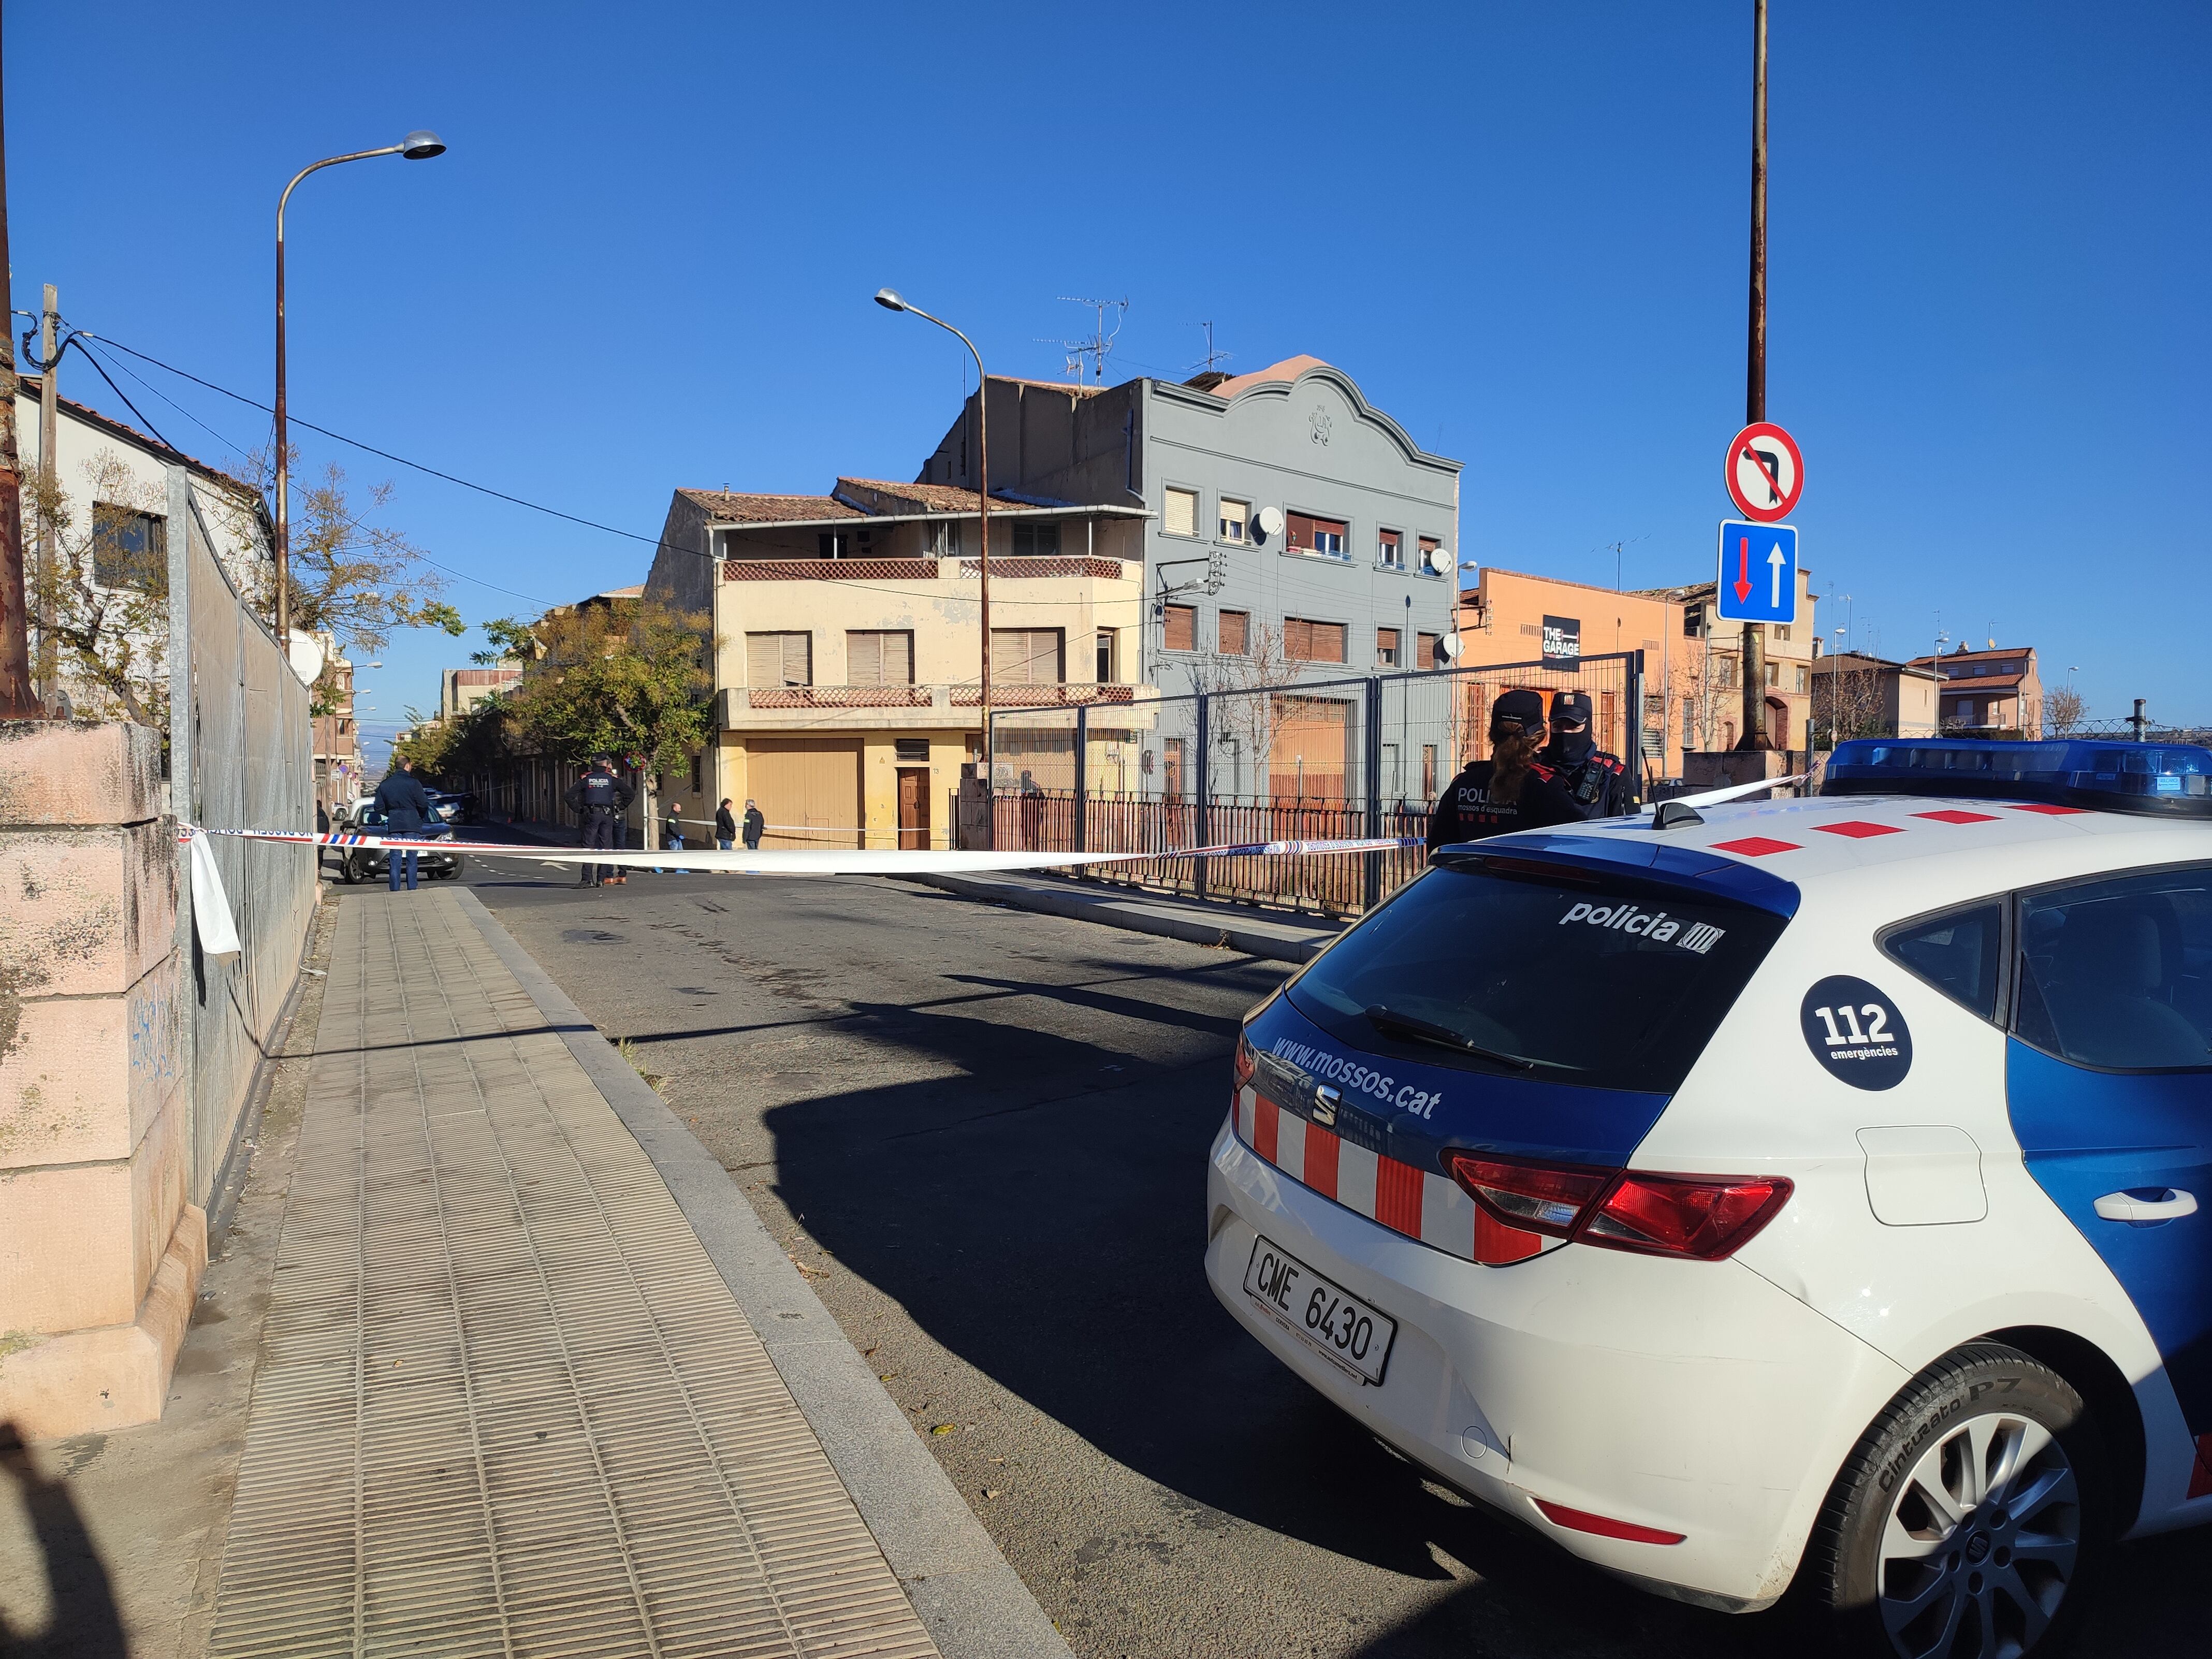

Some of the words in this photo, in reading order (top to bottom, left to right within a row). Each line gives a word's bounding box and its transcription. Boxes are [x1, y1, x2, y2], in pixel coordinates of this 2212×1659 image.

[1544, 627, 1561, 641] THE
[1544, 639, 1579, 656] GARAGE
[1458, 788, 1517, 806] POLI
[1558, 903, 1680, 942] policia
[1815, 1003, 1894, 1045] 112
[1830, 1045, 1898, 1060] emergències
[1272, 1037, 1443, 1120] www.mossos.cat
[1258, 1253, 1299, 1312] CME
[1305, 1287, 1373, 1360] 6430
[1275, 1317, 1290, 1331] CERVERA
[1968, 1377, 2022, 1401] P7
